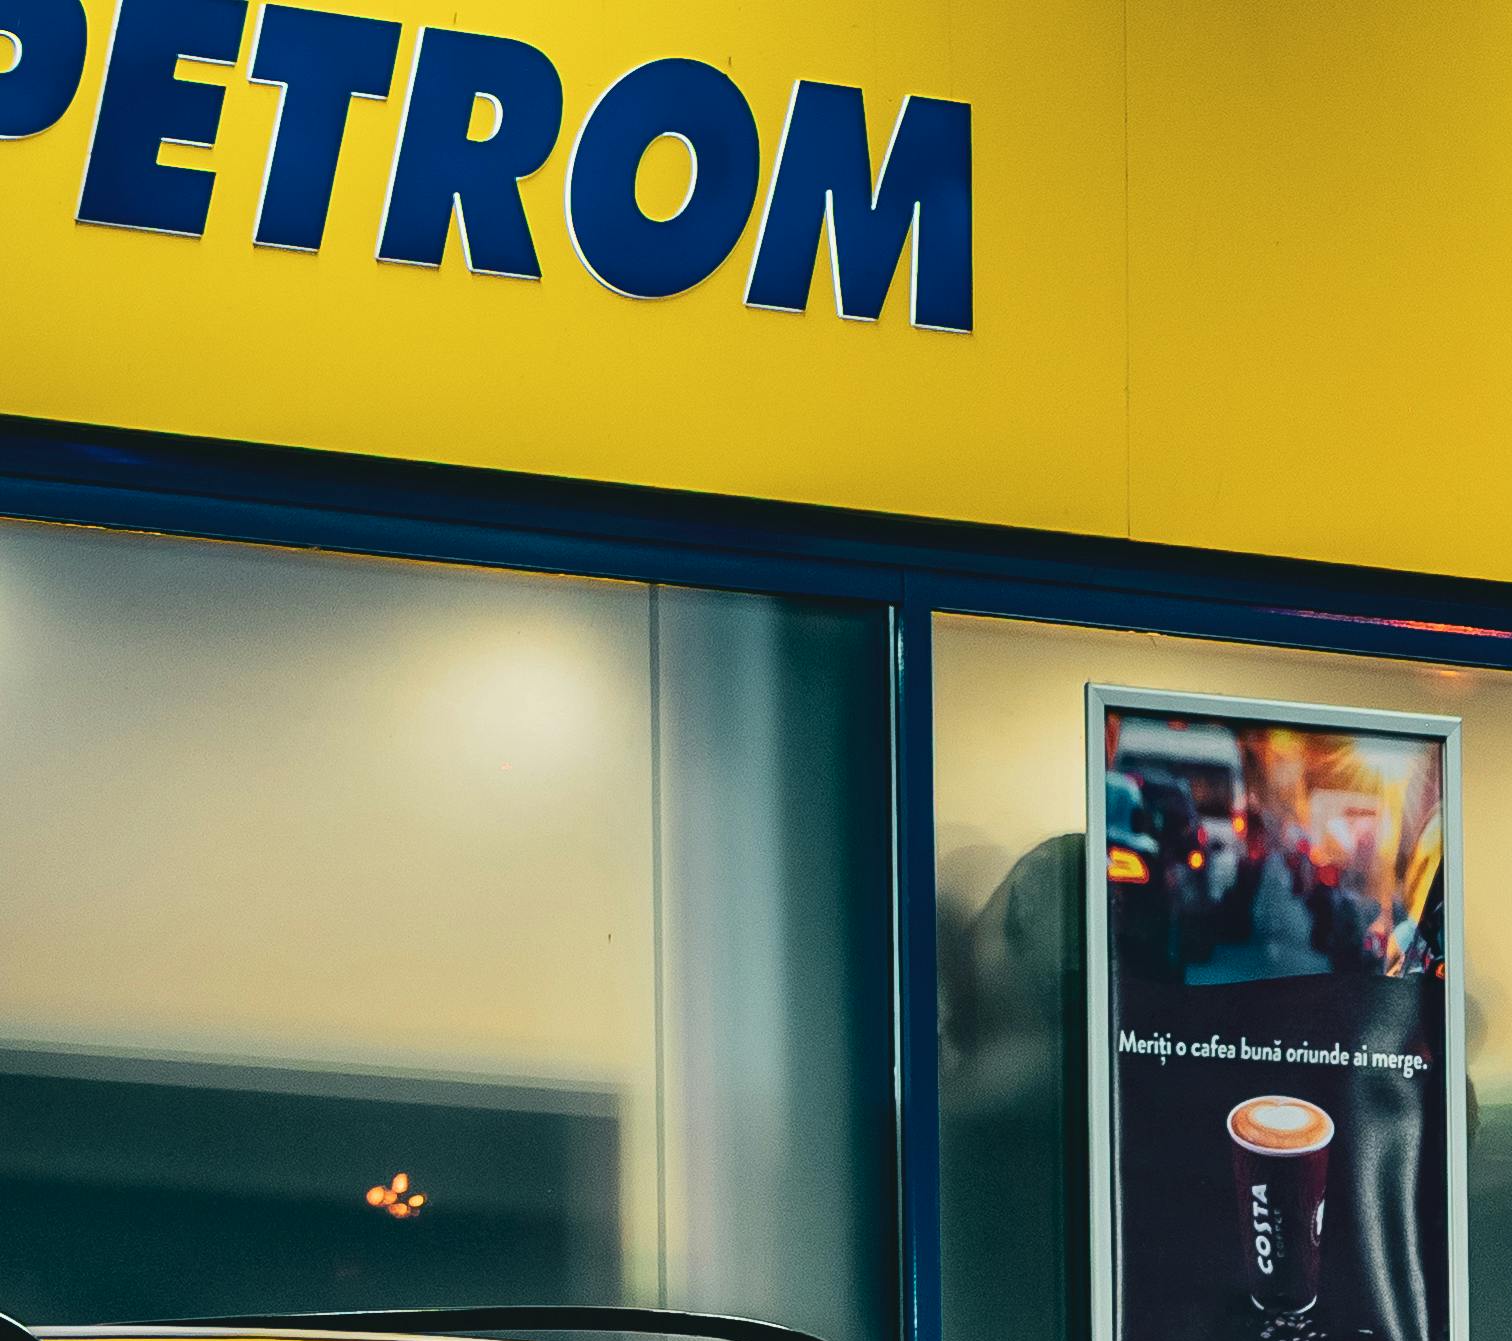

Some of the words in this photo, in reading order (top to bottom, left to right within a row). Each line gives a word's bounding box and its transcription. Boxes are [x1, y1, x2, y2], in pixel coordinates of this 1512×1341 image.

[1119, 1029, 1171, 1066] Meriți
[1176, 1041, 1186, 1056] o
[1191, 1034, 1236, 1059] cafea
[1241, 1037, 1282, 1062] bună
[1286, 1041, 1350, 1065] oriunde
[1354, 1044, 1368, 1067] ai
[1372, 1052, 1428, 1079] merge.
[1251, 1184, 1273, 1274] COSTA
